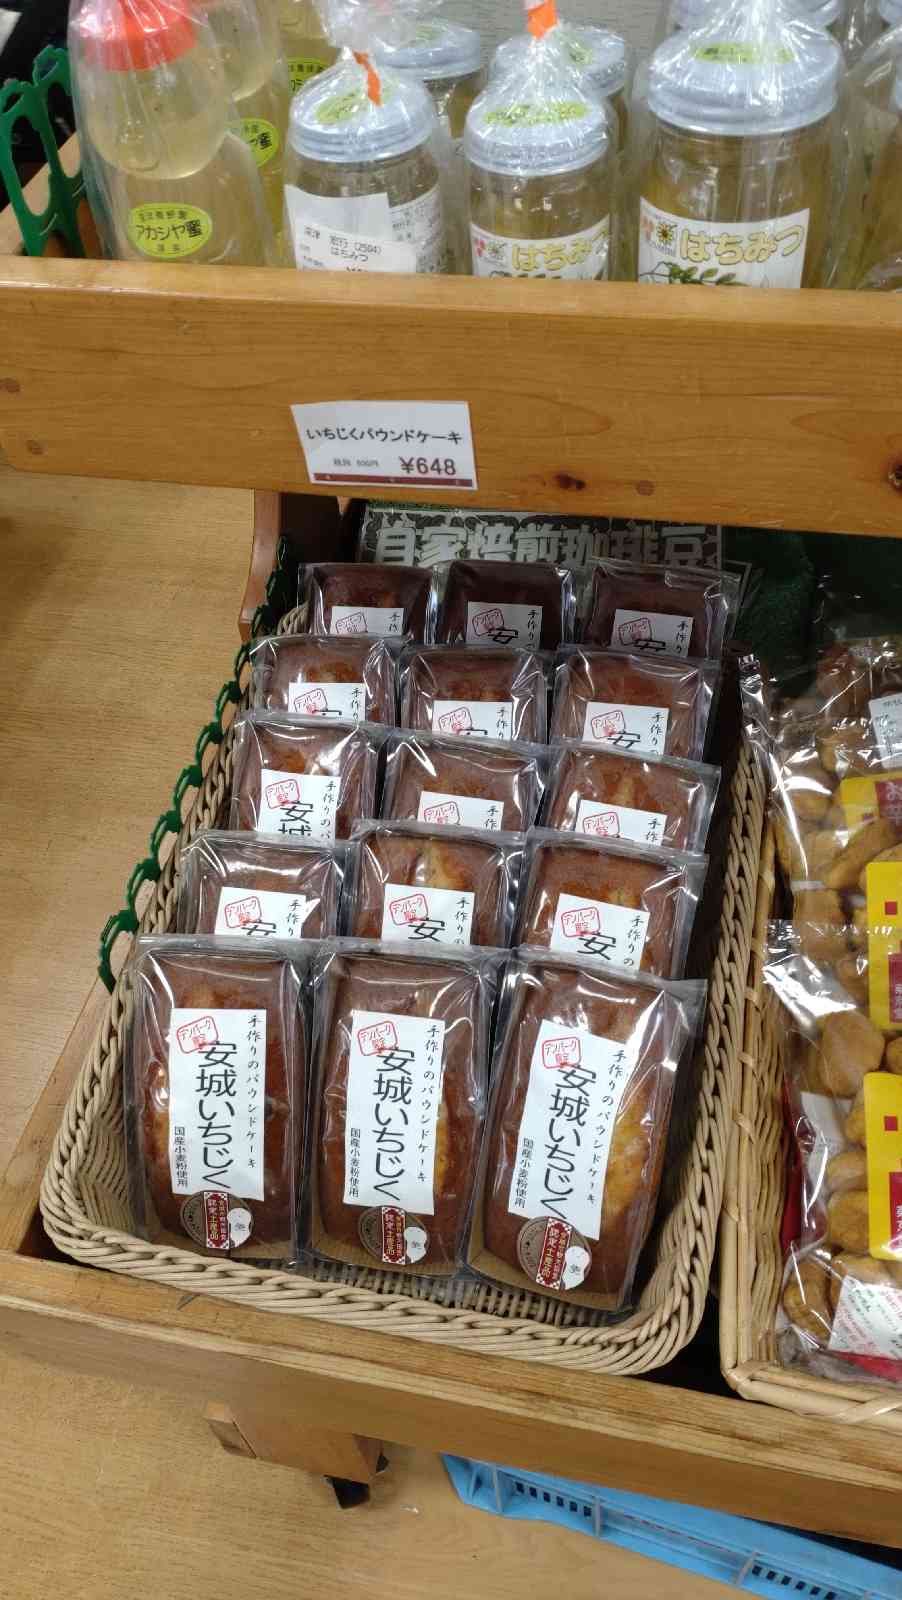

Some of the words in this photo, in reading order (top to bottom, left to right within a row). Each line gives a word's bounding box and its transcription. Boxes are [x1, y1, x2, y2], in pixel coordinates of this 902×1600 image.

[681, 224, 805, 266] はちみつ
[306, 427, 462, 445] いちじくパウンドケーキ
[398, 456, 456, 476] ¥648
[408, 917, 445, 942] 安
[577, 931, 617, 961] 安
[196, 1040, 238, 1189] 安城いちじく
[246, 1014, 261, 1169] 手作りのパウンドケーキ
[372, 1046, 416, 1201] 安城いちじく
[416, 1023, 441, 1184] 手作りのパウンドケーキ
[586, 1049, 628, 1205] 手作りのパウンドケーキ
[173, 1126, 189, 1188] 国産小麦粉使用
[348, 1127, 361, 1199] 国産小麦粉使用
[513, 1137, 534, 1210] 国産小麦粉使用
[540, 1064, 598, 1220] 安城いちじく
